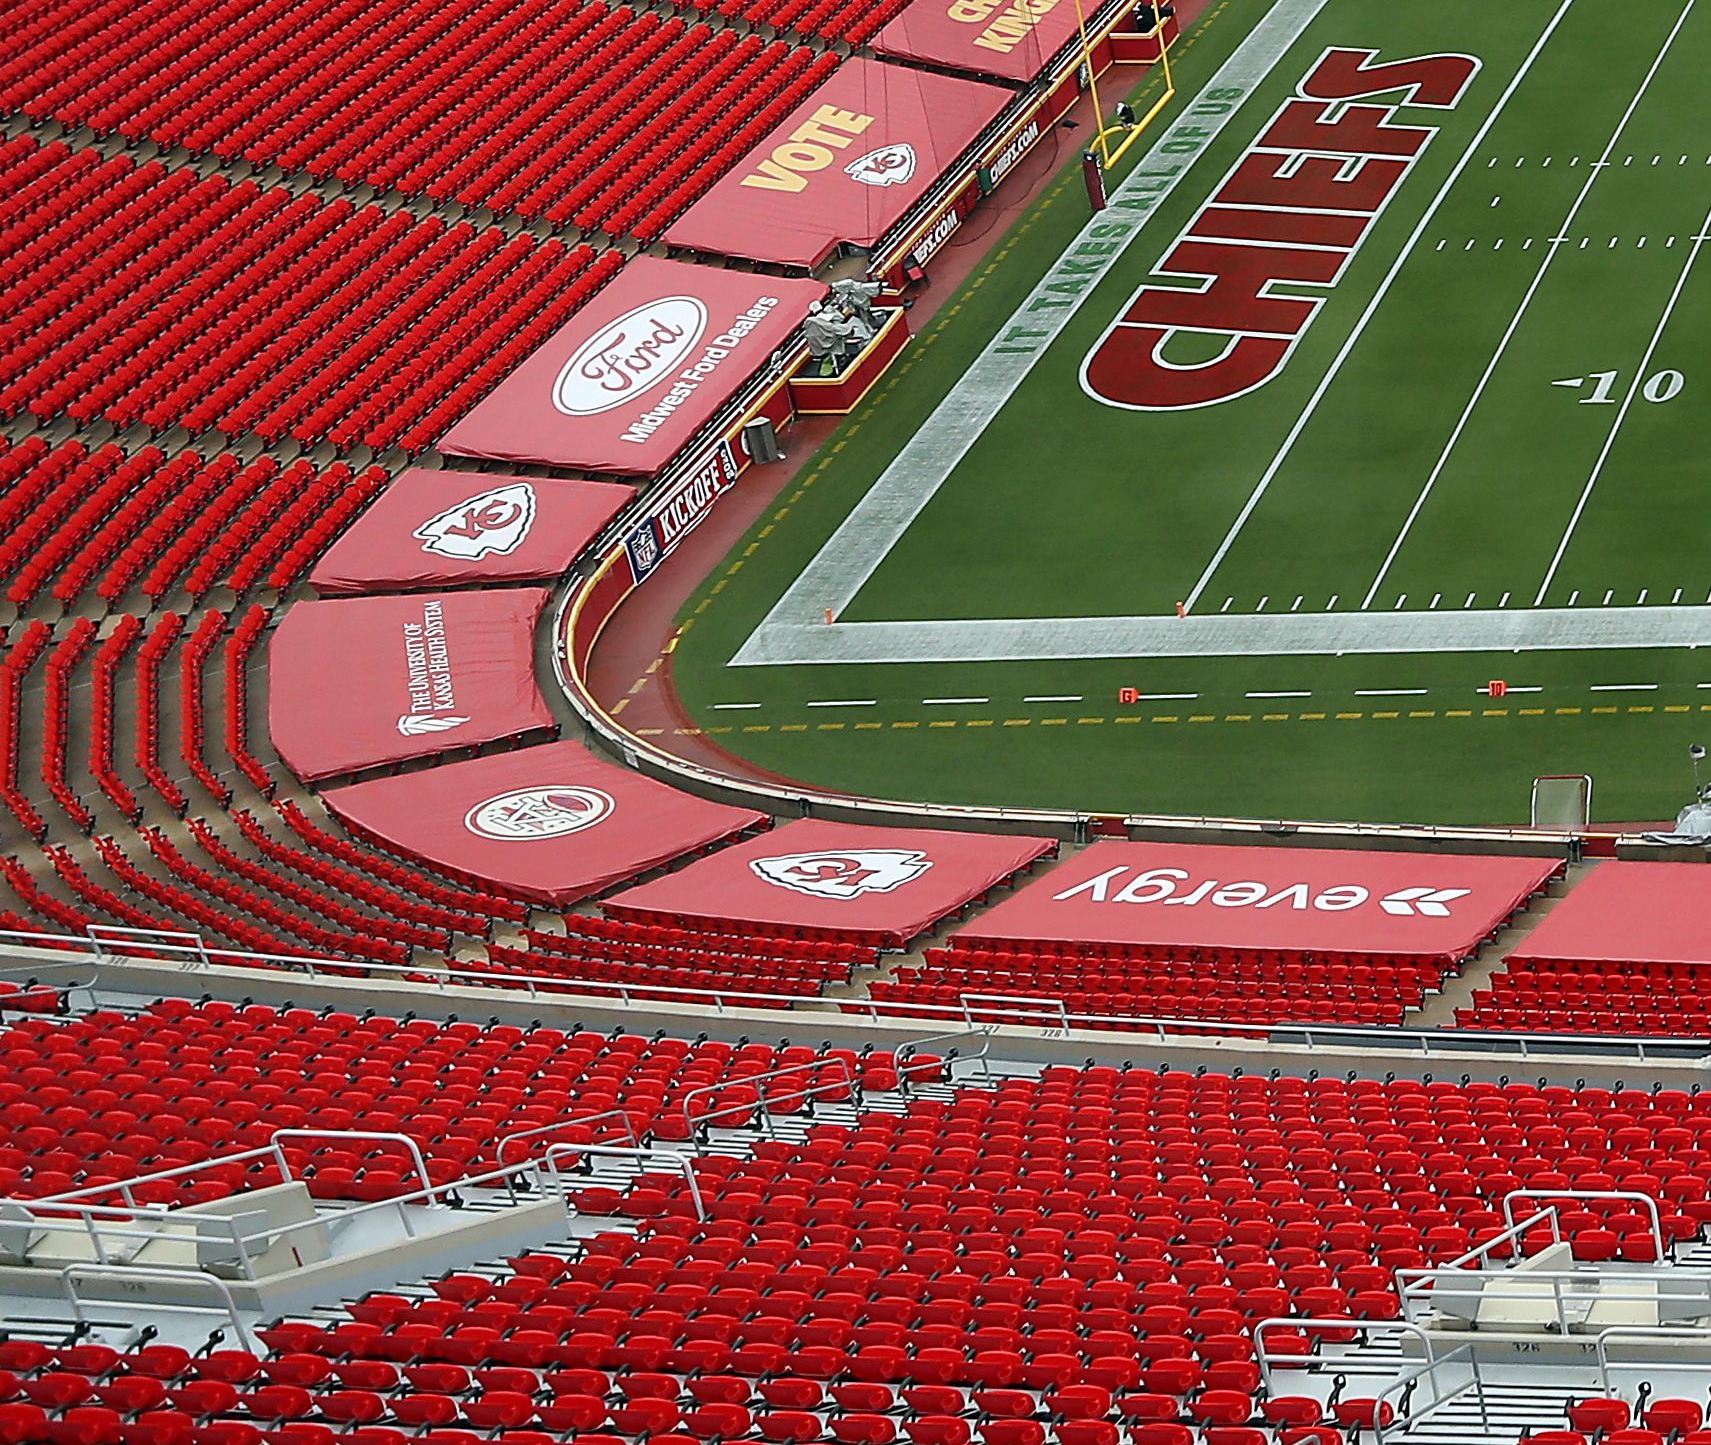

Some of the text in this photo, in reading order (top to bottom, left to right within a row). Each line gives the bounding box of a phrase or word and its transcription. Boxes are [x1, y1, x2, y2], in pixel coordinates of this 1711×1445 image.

[740, 104, 875, 193] VOTE
[988, 121, 1040, 185] CHIEFS.COM
[993, 87, 1245, 355] IT TAKES ALL OF US
[1078, 44, 1485, 413] CHIEFS
[580, 318, 685, 393] Ford
[619, 296, 780, 445] Midwest Ford Dealers
[1579, 369, 1685, 403] 10
[659, 459, 722, 545] KICKOFF
[1049, 864, 1371, 913] evergy
